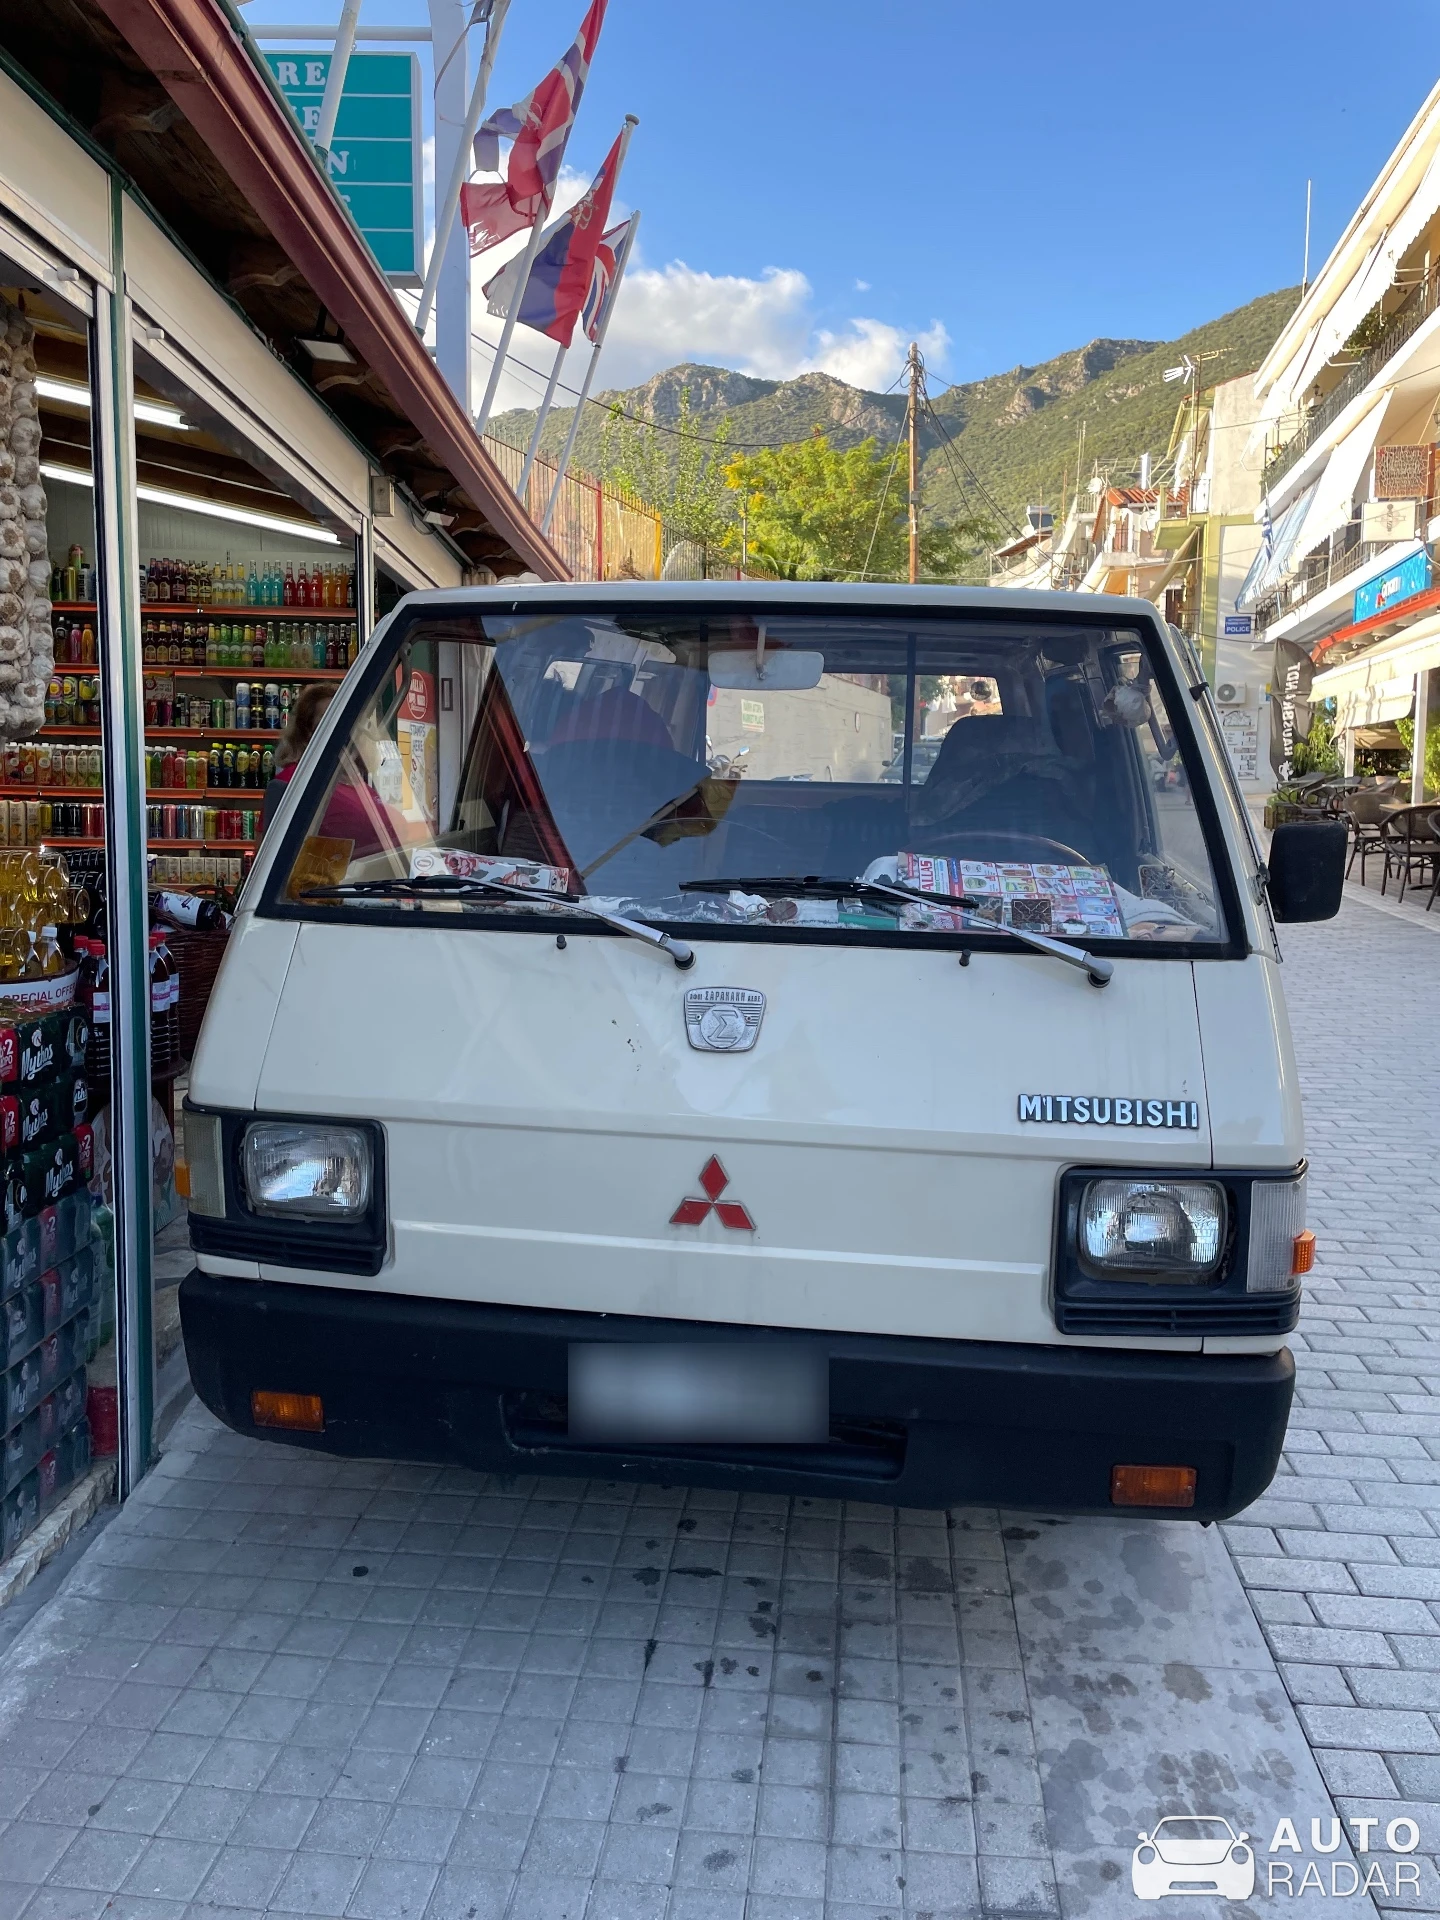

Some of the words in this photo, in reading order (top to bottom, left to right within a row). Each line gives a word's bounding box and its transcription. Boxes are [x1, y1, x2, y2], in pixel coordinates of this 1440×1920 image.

[270, 61, 326, 86] RE
[705, 990, 746, 1002] ΣΑΡΑΚΑΚΗ
[21, 1043, 54, 1081] Mythos
[22, 1109, 49, 1143] Mythos
[1019, 1094, 1199, 1128] MITSUBISHI
[45, 1160, 73, 1197] Mythos
